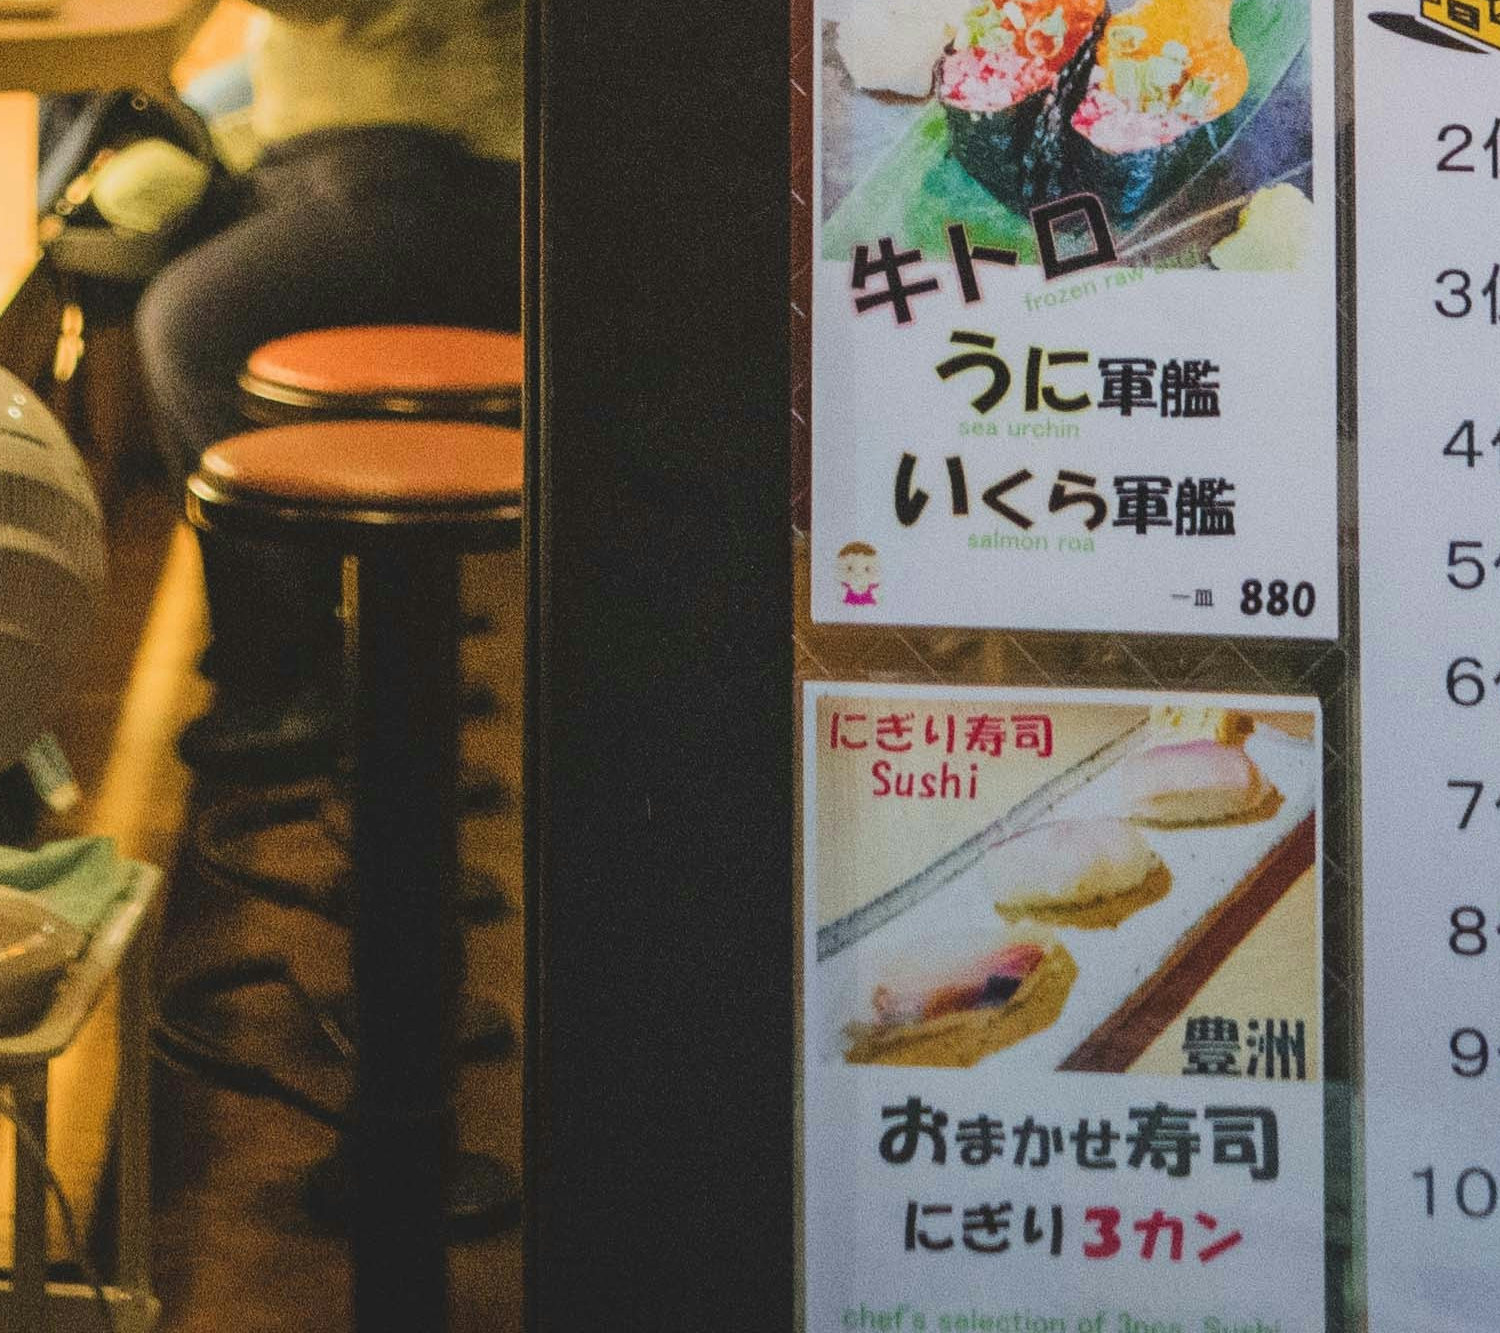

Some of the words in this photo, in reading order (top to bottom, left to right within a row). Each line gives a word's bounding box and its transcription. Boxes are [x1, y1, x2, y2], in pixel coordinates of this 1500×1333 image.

[850, 190, 1118, 325] 牛トロ
[1024, 279, 1098, 311] frozen
[934, 329, 1222, 419] うに軍艦
[892, 450, 1238, 538] いくら軍艦
[1239, 579, 1318, 619] 880
[828, 711, 1055, 758] にぎり寿司
[871, 761, 981, 801] Sushi
[877, 1095, 1281, 1183] おまかせ寿司
